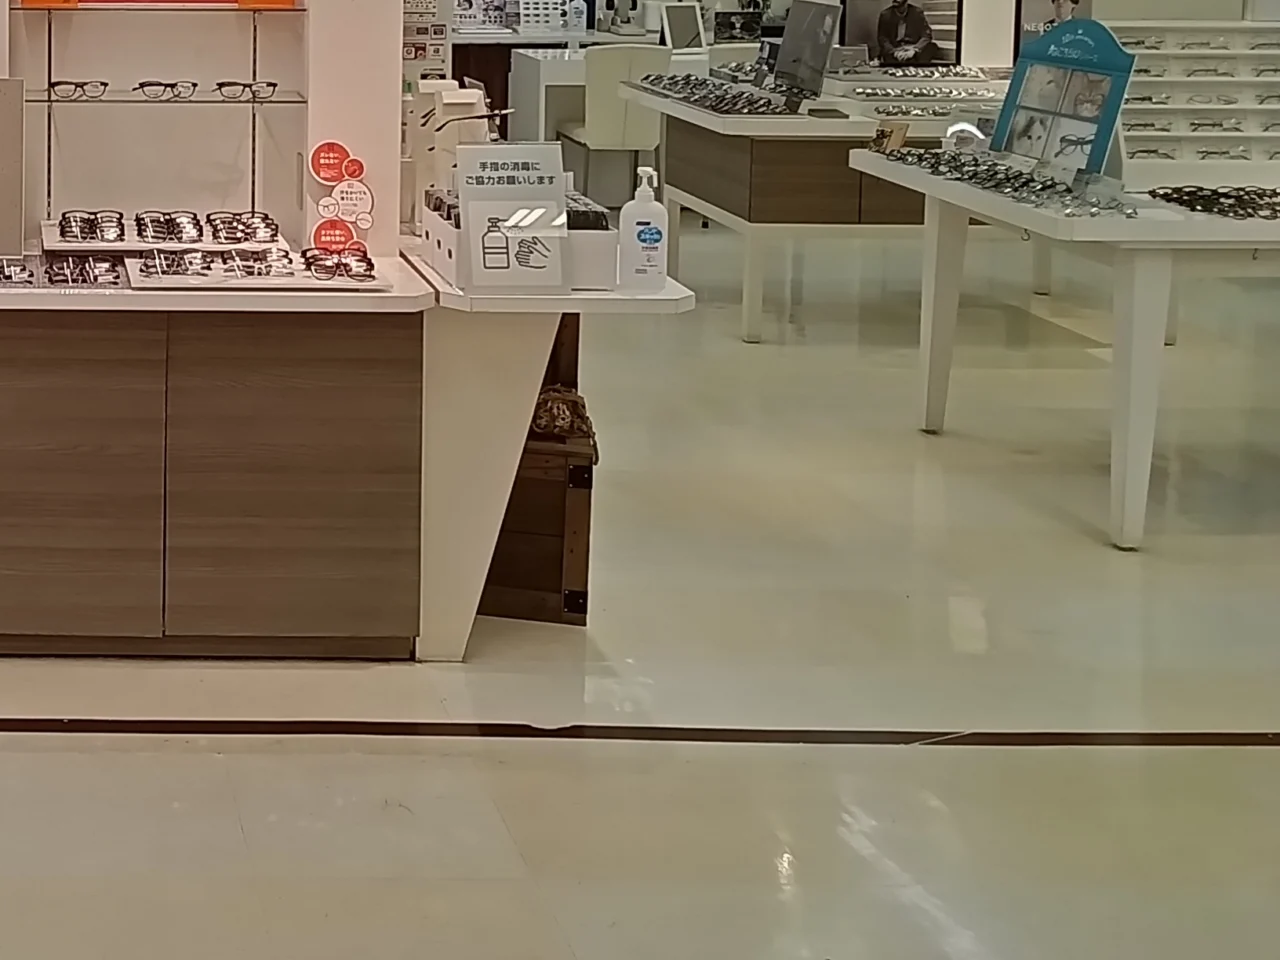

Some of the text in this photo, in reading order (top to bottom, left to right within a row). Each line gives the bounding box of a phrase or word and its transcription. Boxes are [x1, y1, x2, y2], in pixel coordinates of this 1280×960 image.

[479, 162, 541, 172] 手指の消毒に
[465, 176, 556, 186] ご協力お願いします
